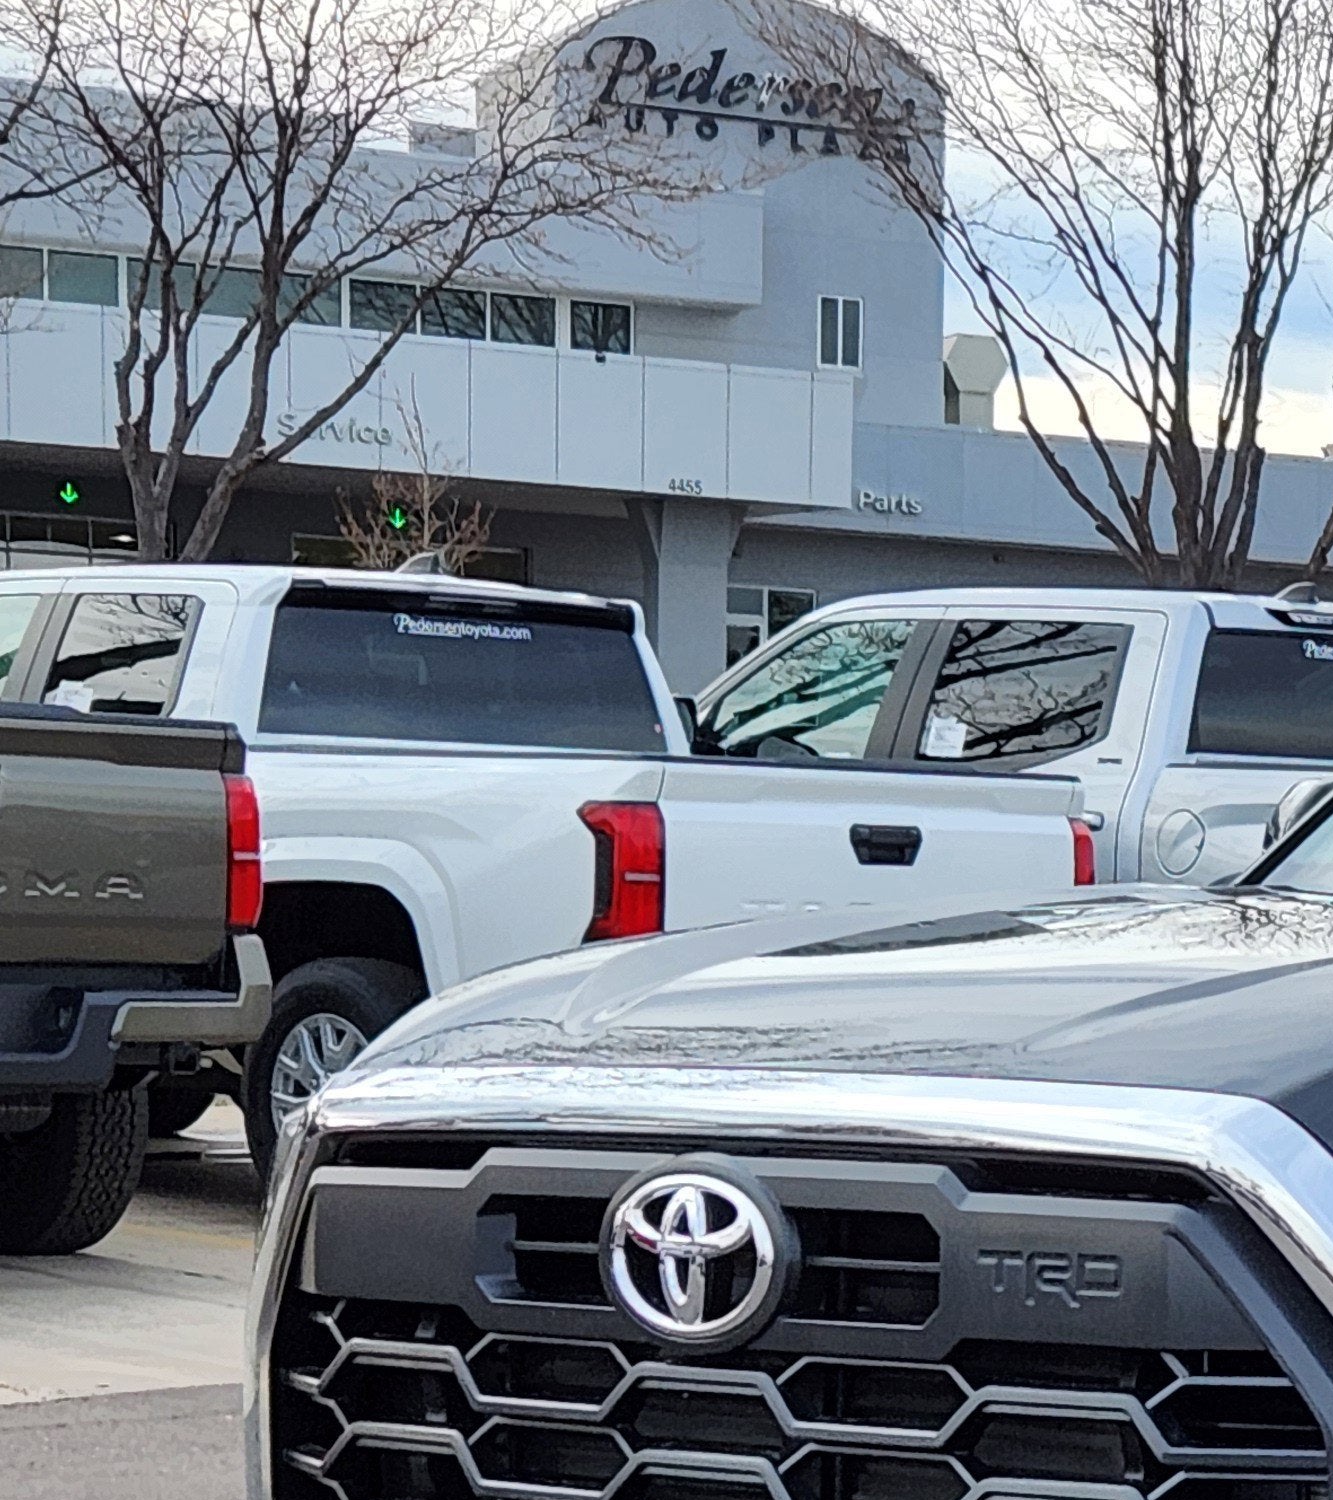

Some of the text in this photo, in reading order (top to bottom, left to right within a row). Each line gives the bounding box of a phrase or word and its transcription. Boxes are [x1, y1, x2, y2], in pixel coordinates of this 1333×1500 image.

[583, 35, 916, 127] Pedersen
[277, 414, 392, 446] Srvice
[668, 478, 703, 495] 4455
[857, 489, 923, 514] Parts
[0, 870, 143, 899] MA
[977, 1250, 1123, 1308] TRD
